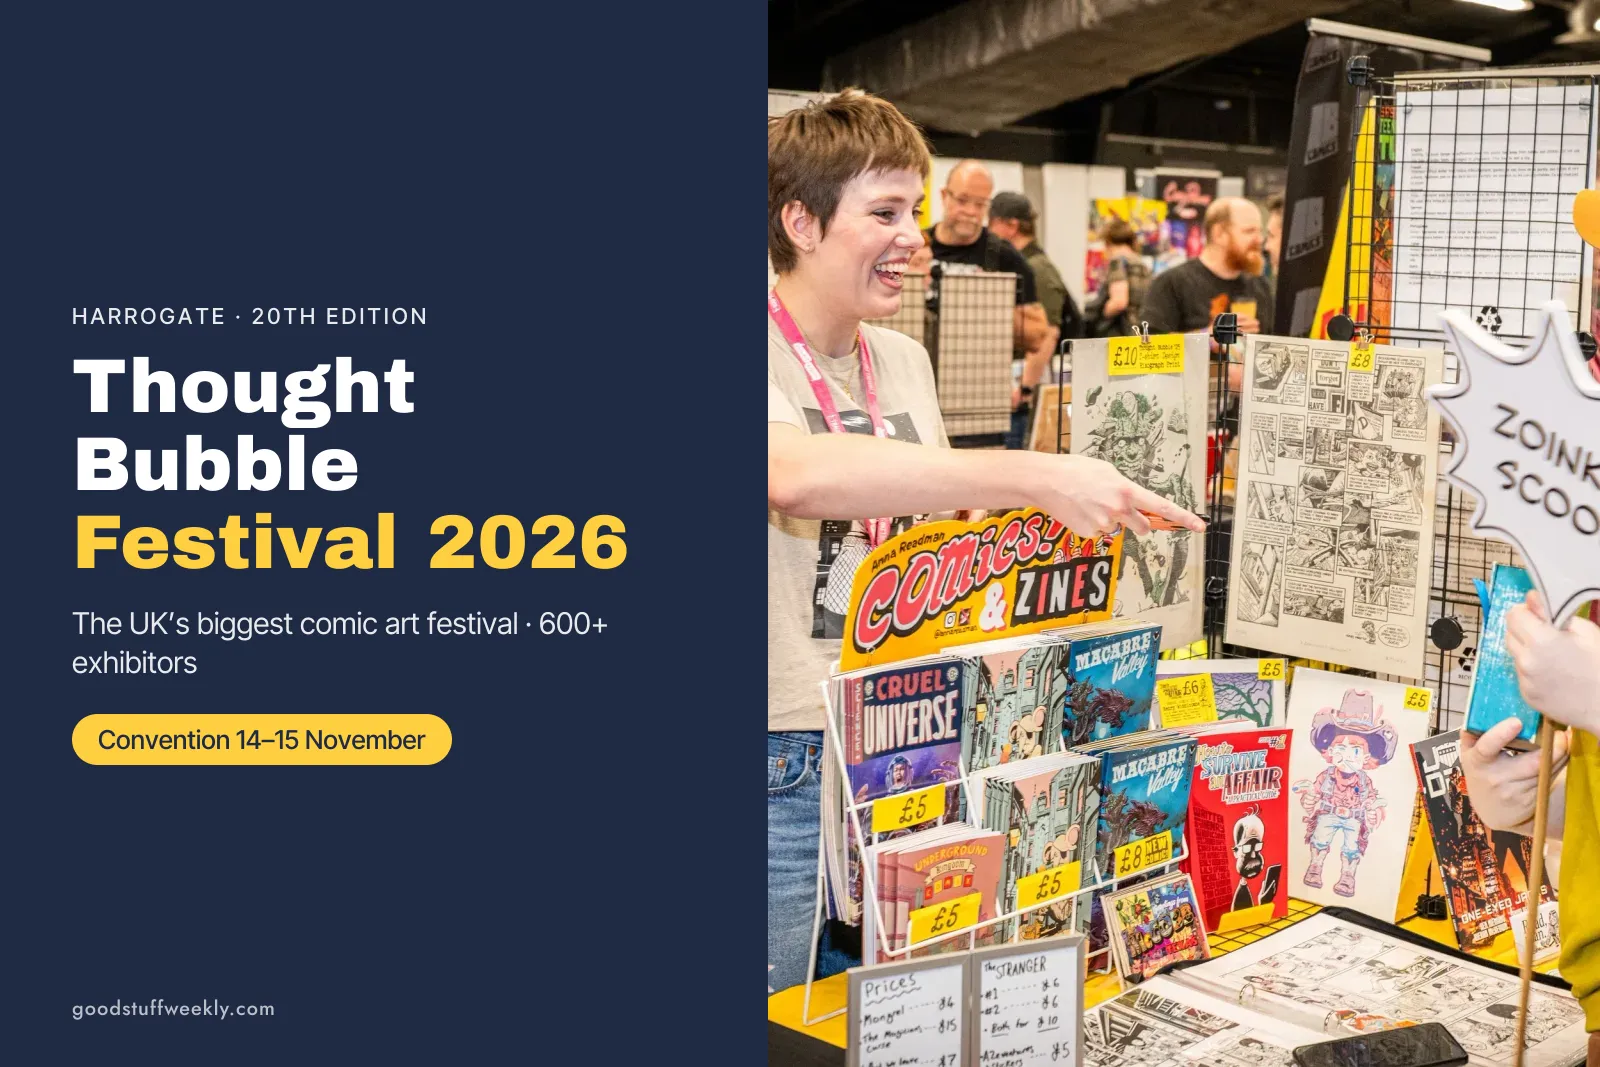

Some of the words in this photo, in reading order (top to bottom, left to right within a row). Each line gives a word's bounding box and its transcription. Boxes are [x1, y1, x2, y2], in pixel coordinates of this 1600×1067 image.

[1113, 346, 1138, 367] £10
[1351, 353, 1371, 368] £8
[871, 551, 897, 573] Anna
[899, 531, 945, 553] Readman
[979, 582, 1006, 632] &
[1014, 562, 1110, 616] ZINES
[1075, 631, 1151, 671] MACABRE
[1112, 652, 1149, 684] Valley
[1262, 662, 1281, 677] £5
[876, 669, 946, 700] CRUEL
[1183, 680, 1199, 695] £6
[1407, 692, 1427, 707] £5
[864, 690, 958, 755] UNIVERSE
[1112, 744, 1188, 784] MACABRE
[1201, 750, 1268, 778] SURVIVE
[1147, 766, 1184, 797] Valley
[1223, 767, 1283, 796] AFFAIR
[899, 794, 928, 824] £5
[914, 843, 989, 873] UNDERGROUND
[1120, 845, 1143, 873] £8
[1144, 835, 1169, 854] NEW
[1036, 870, 1062, 900] £5
[931, 903, 960, 933] £5
[1461, 897, 1512, 925] ONE-EYED
[995, 955, 1047, 980] STRANGER
[865, 973, 917, 998] Prices
[863, 1005, 905, 1027] Mongrel
[863, 1032, 878, 1043] The
